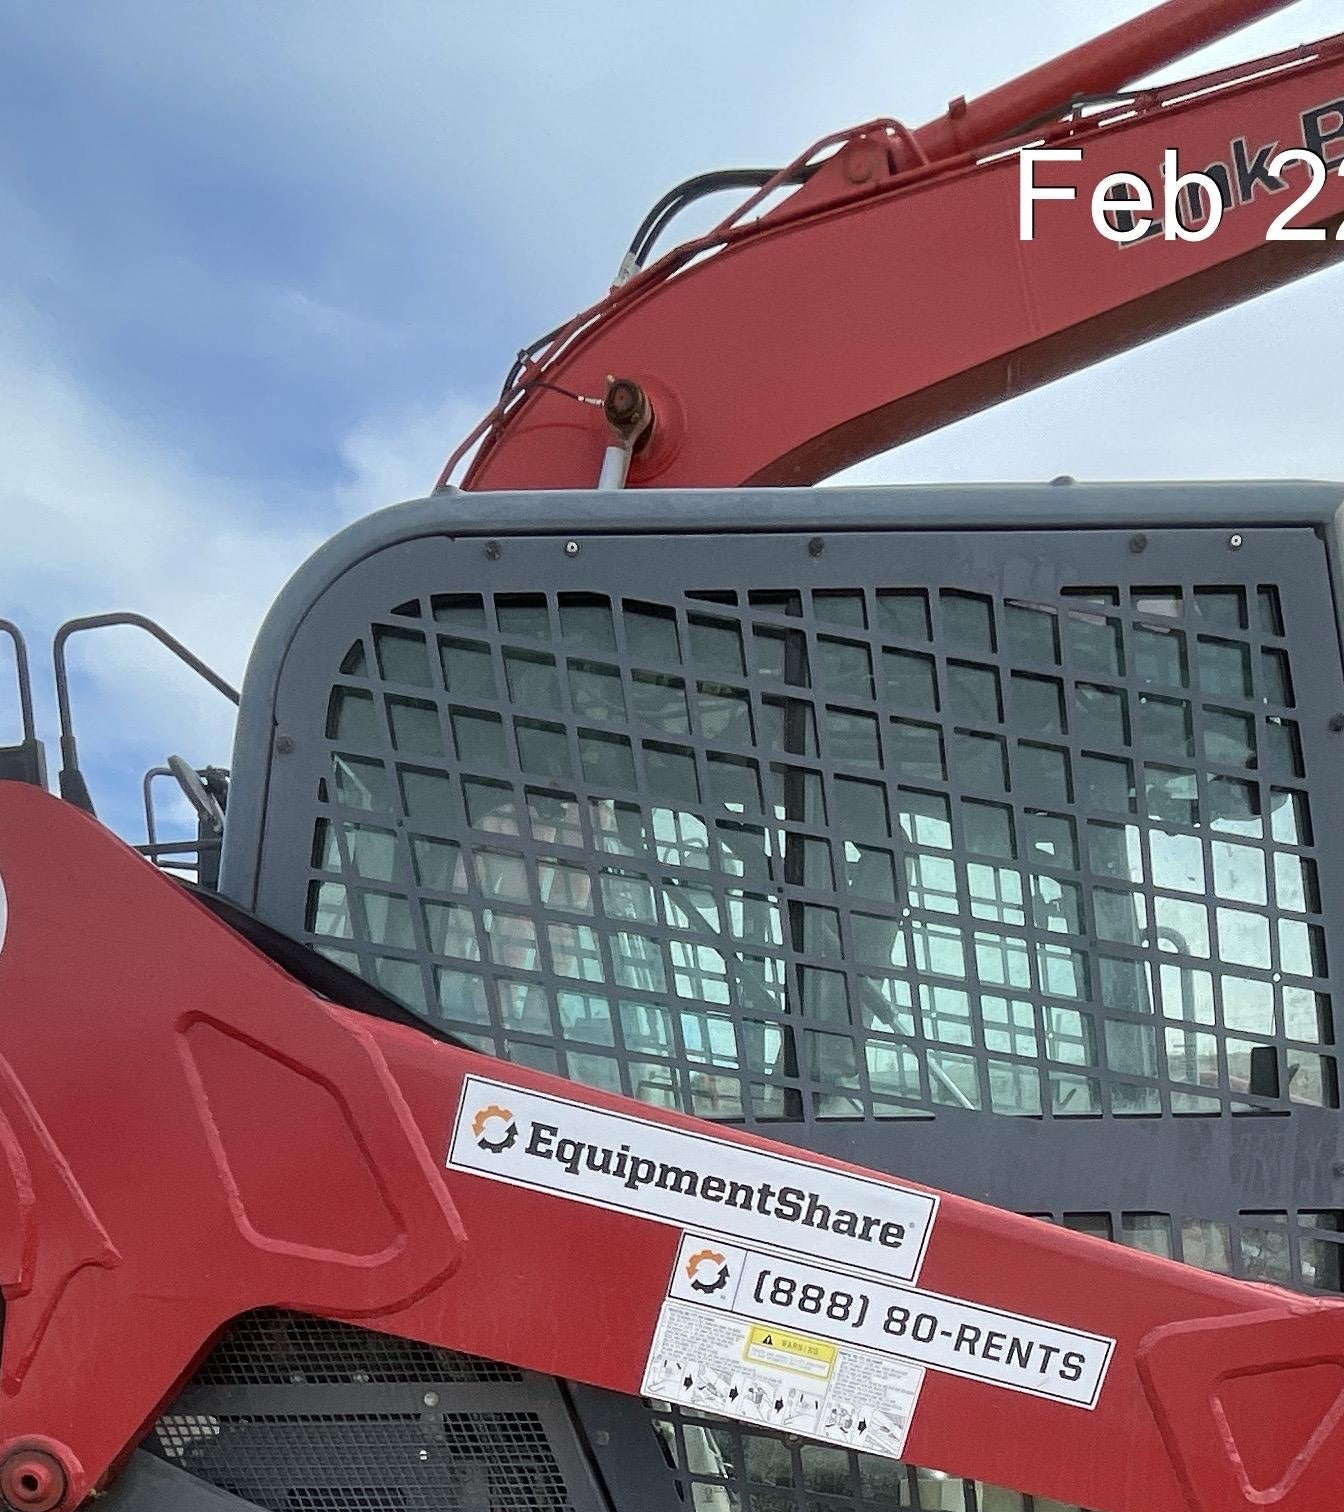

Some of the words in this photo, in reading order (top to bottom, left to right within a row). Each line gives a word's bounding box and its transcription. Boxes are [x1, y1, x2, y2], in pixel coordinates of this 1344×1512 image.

[524, 1120, 906, 1249] EquipmentShare
[753, 1269, 869, 1328] (888)
[883, 1304, 1087, 1383] 80-RENTS
